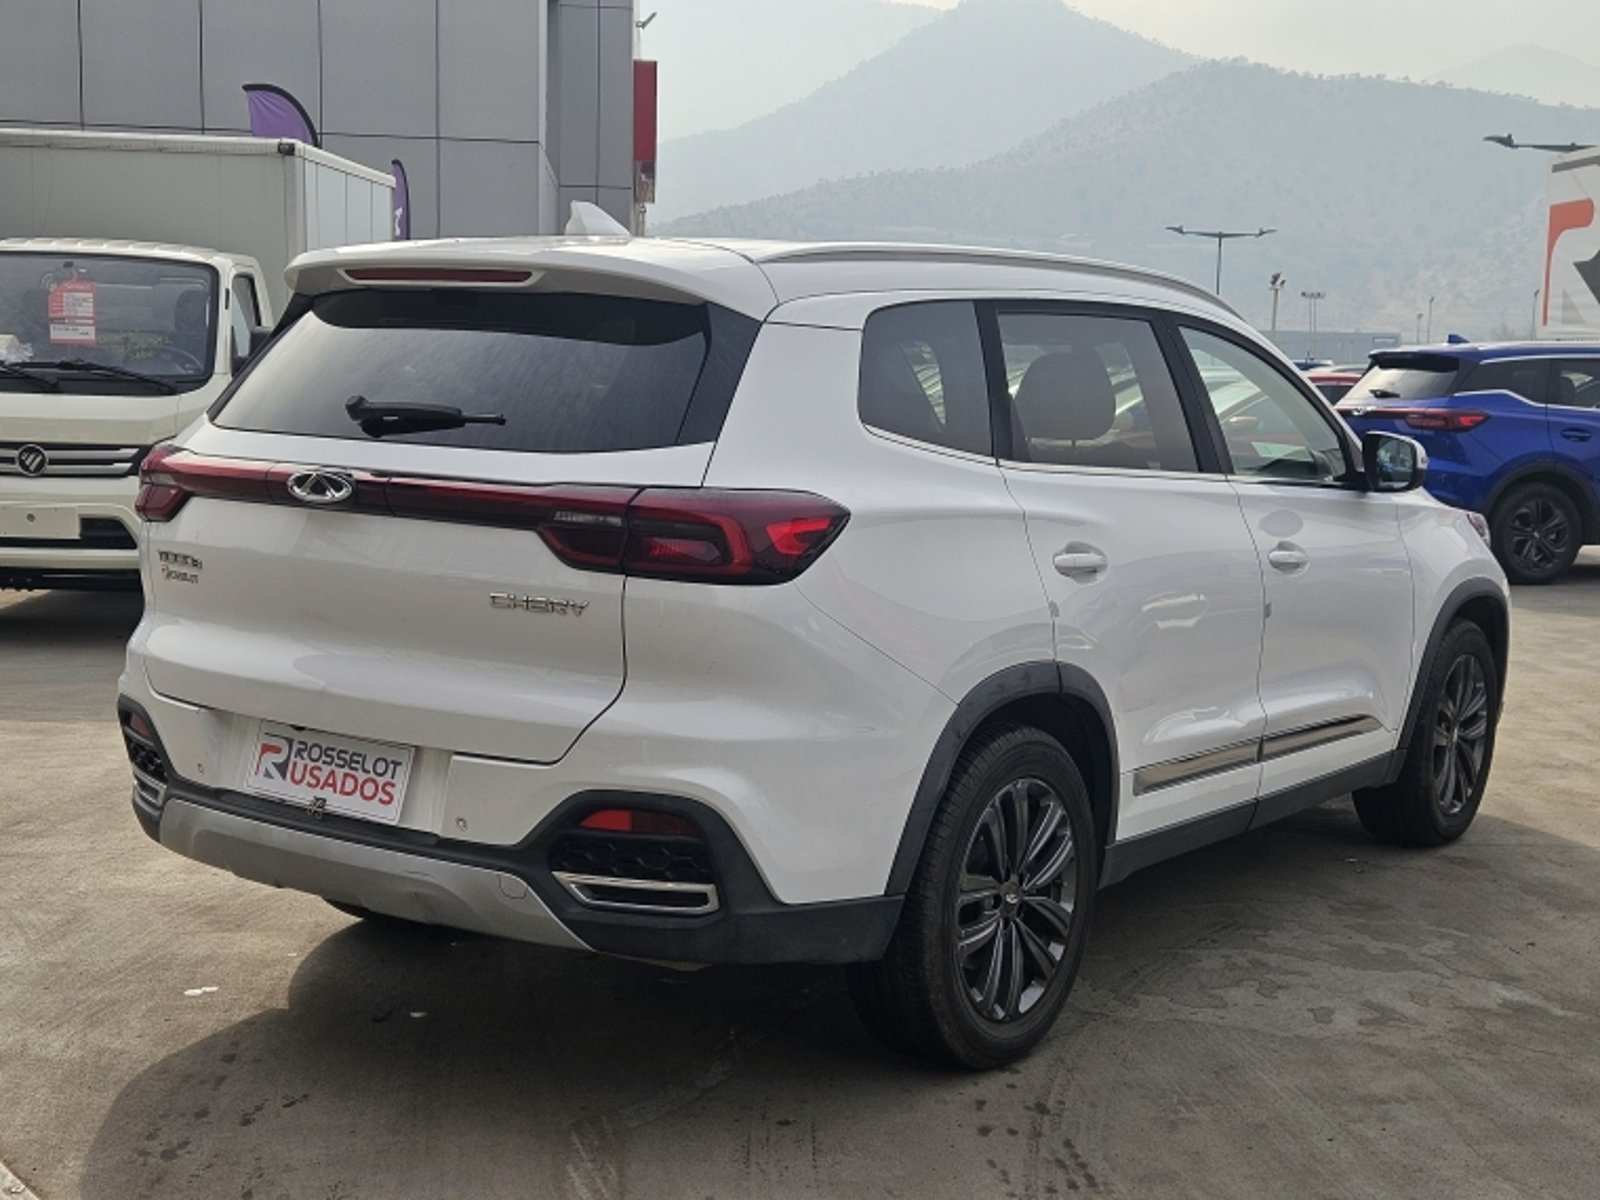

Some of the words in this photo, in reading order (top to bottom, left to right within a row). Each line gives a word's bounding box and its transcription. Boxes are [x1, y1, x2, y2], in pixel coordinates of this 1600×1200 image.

[489, 592, 590, 617] CHERY
[294, 740, 403, 780] ROSSELOT
[290, 760, 397, 806] USADOS
